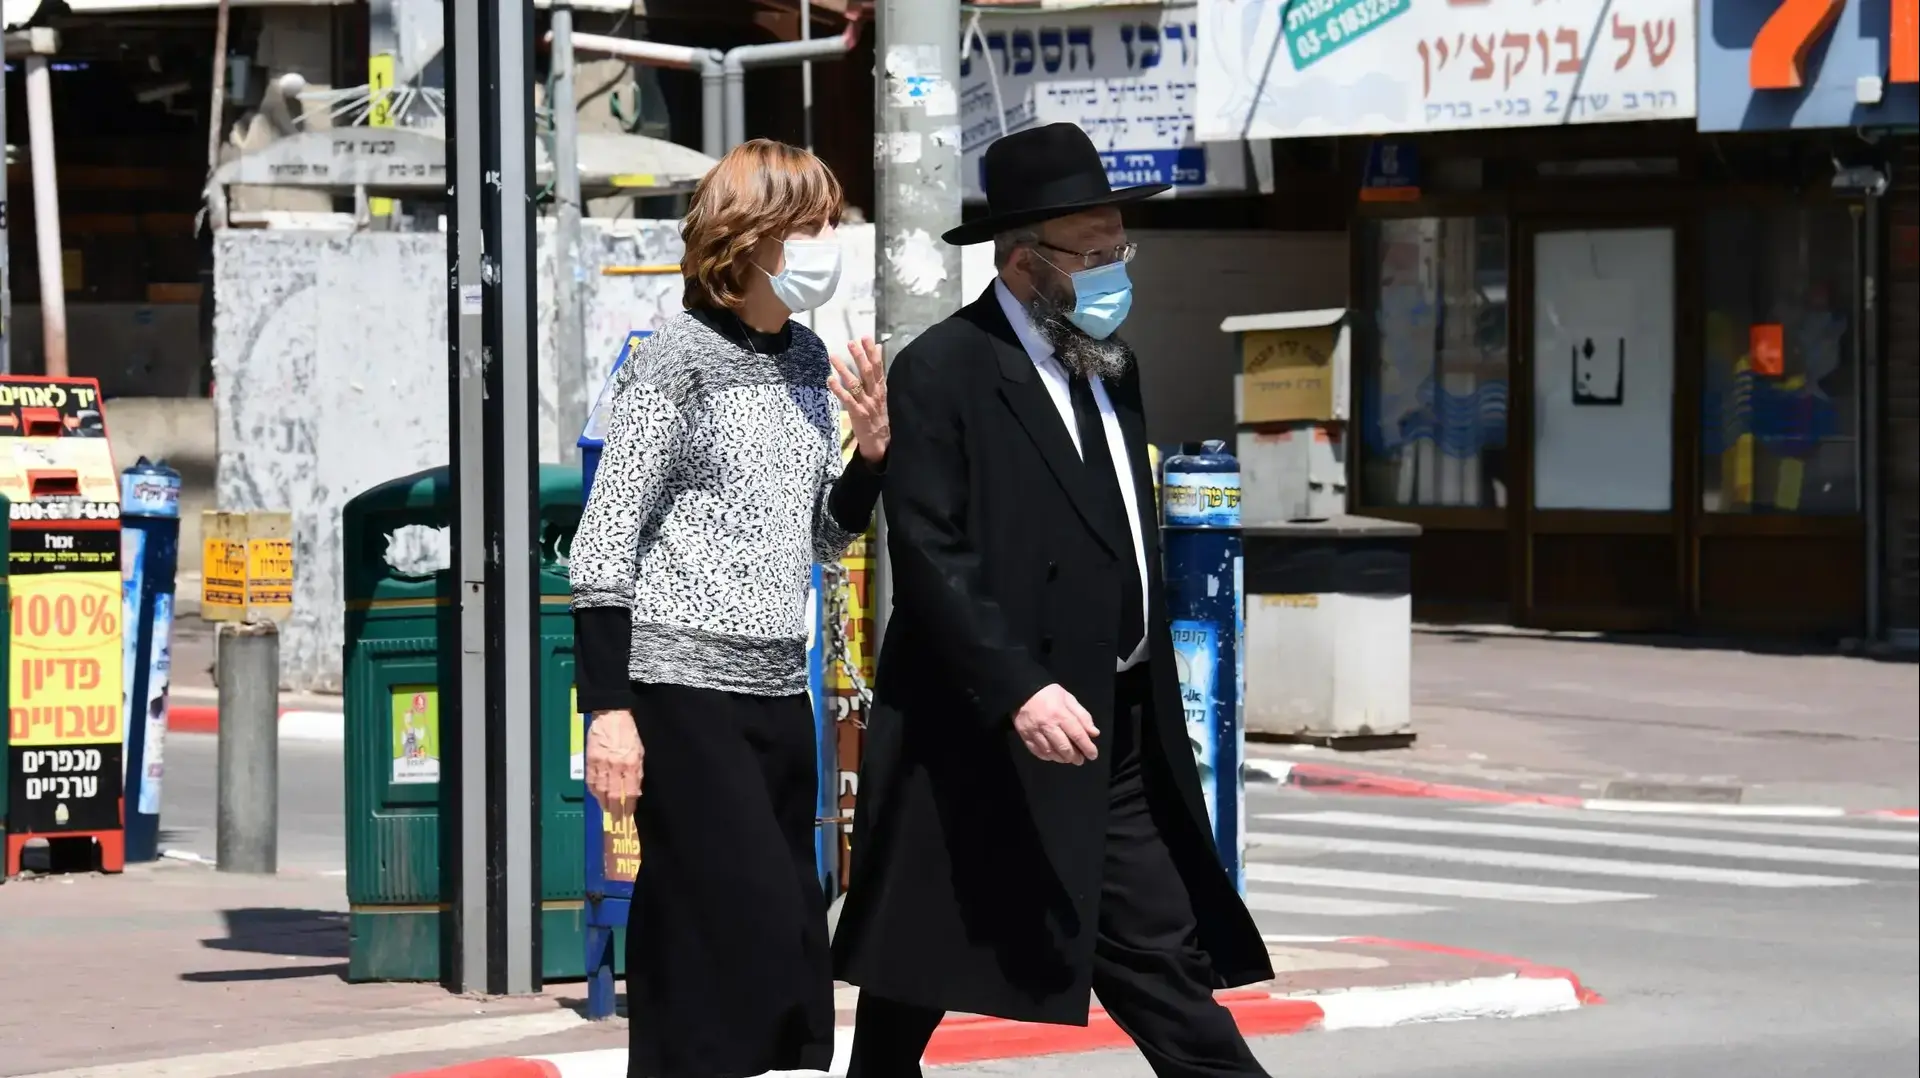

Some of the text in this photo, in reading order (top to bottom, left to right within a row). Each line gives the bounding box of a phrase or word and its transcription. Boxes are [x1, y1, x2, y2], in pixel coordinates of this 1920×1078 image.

[1120, 22, 1197, 70] רכז
[1612, 11, 1676, 72] של
[1544, 90, 1560, 113] 2
[1622, 91, 1677, 108] הרב
[0, 384, 95, 408] יד לאחים
[1199, 486, 1223, 512] מרן
[10, 593, 116, 637] 100%
[22, 658, 101, 700] פדיון
[9, 705, 116, 739] שבויים
[22, 749, 101, 773] מכפרים
[26, 776, 98, 800] ערביים
